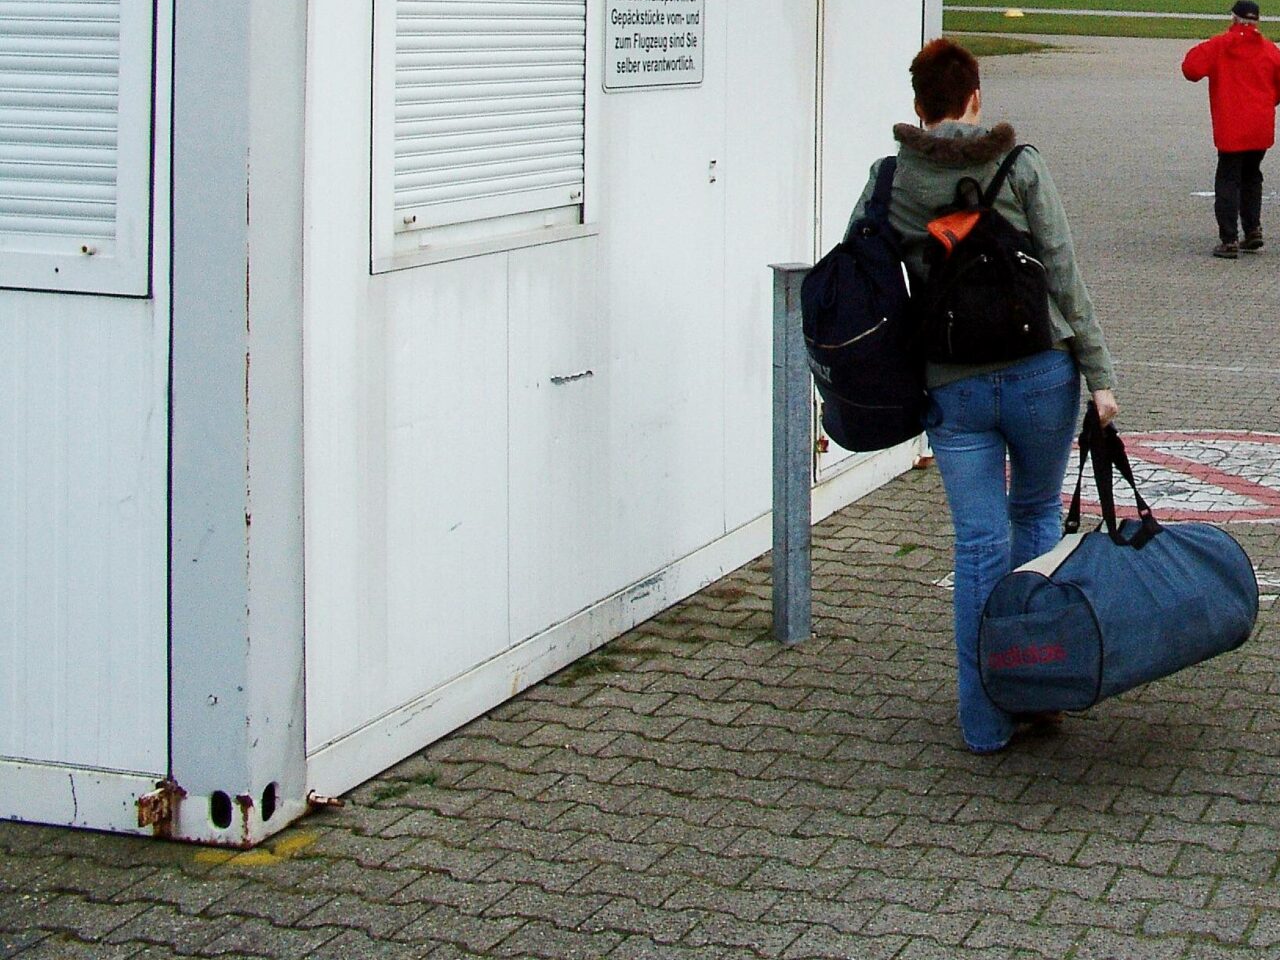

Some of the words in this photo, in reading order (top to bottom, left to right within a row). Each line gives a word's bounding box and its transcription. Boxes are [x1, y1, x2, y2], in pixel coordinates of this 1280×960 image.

[611, 8, 665, 29] Gepäckstücke
[686, 10, 699, 24] und
[615, 37, 631, 49] zum
[634, 32, 667, 52] Flugzeug
[670, 32, 684, 48] sind
[687, 32, 697, 48] Sie
[617, 57, 640, 73] selber
[642, 55, 695, 72] verantwortlich.
